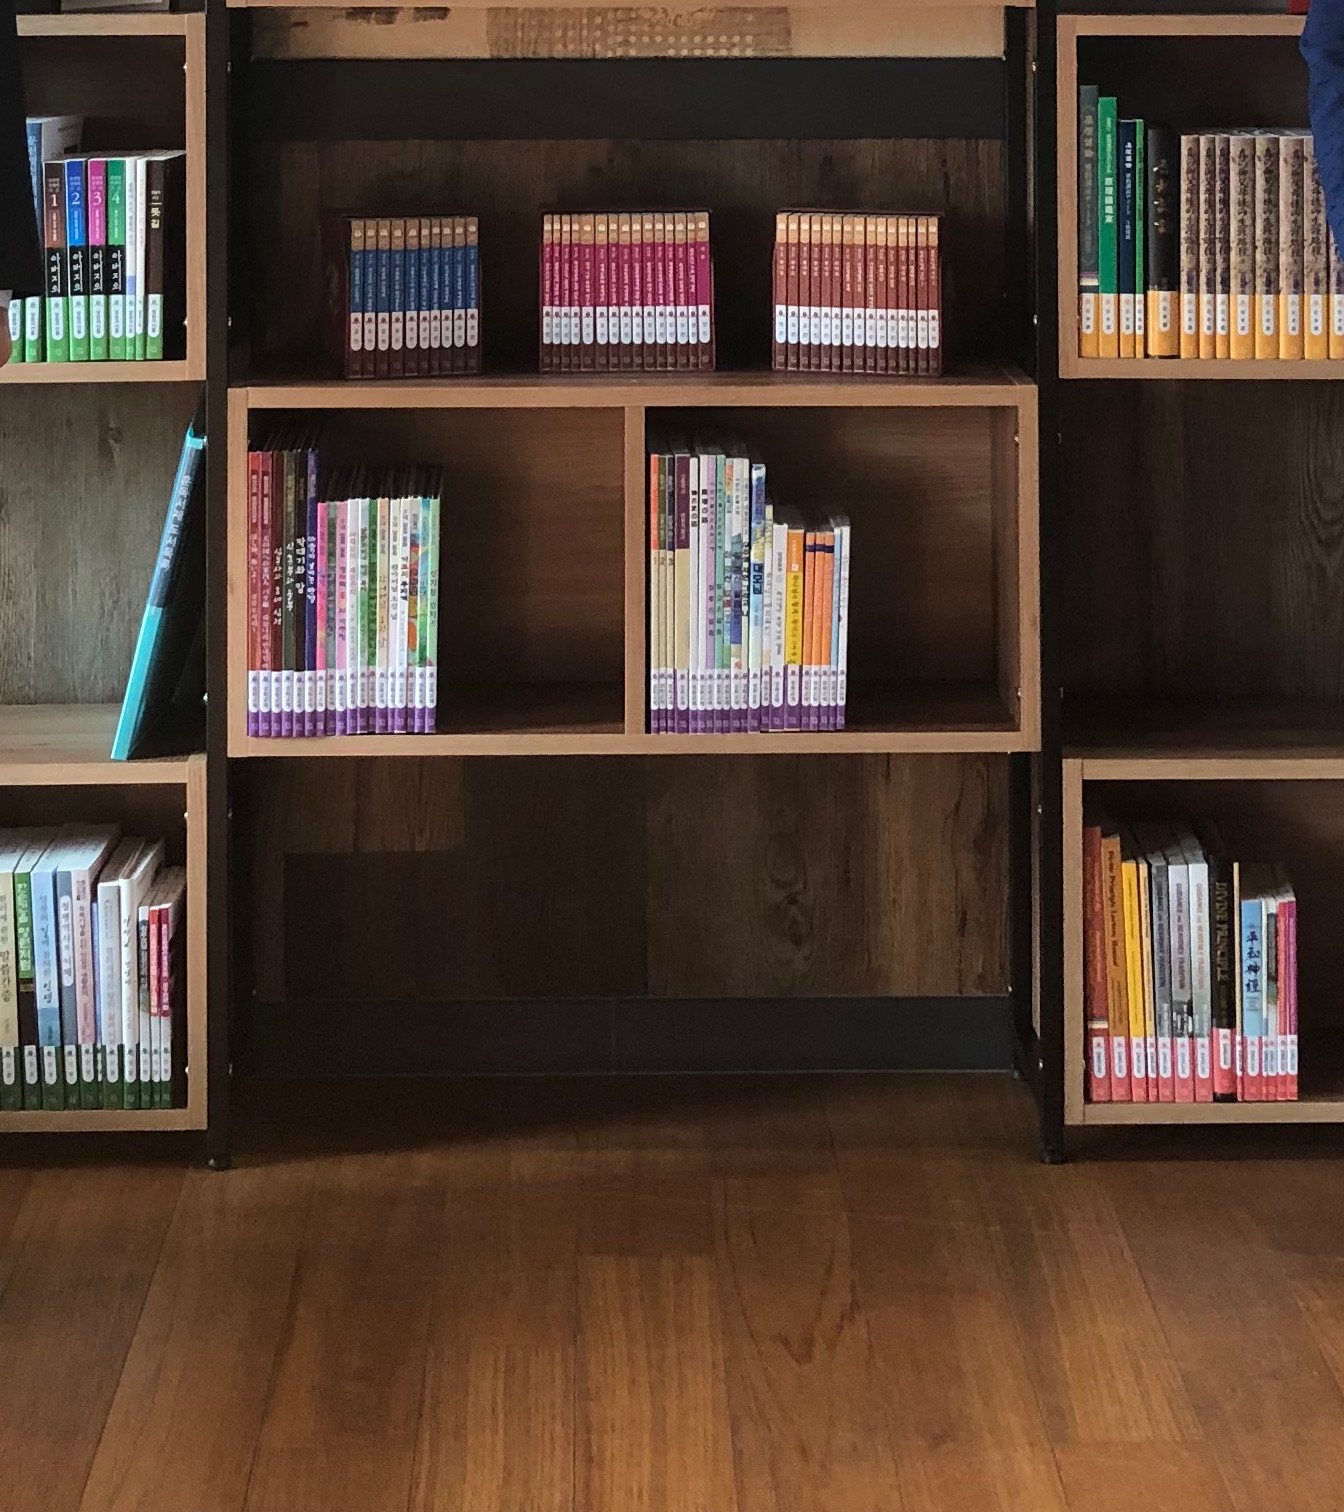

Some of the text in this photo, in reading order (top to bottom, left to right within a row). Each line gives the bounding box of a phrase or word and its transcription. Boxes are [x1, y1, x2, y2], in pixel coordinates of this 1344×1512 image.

[50, 193, 58, 207] 1
[71, 191, 81, 206] 2
[91, 191, 102, 206] 3
[111, 190, 121, 204] 4
